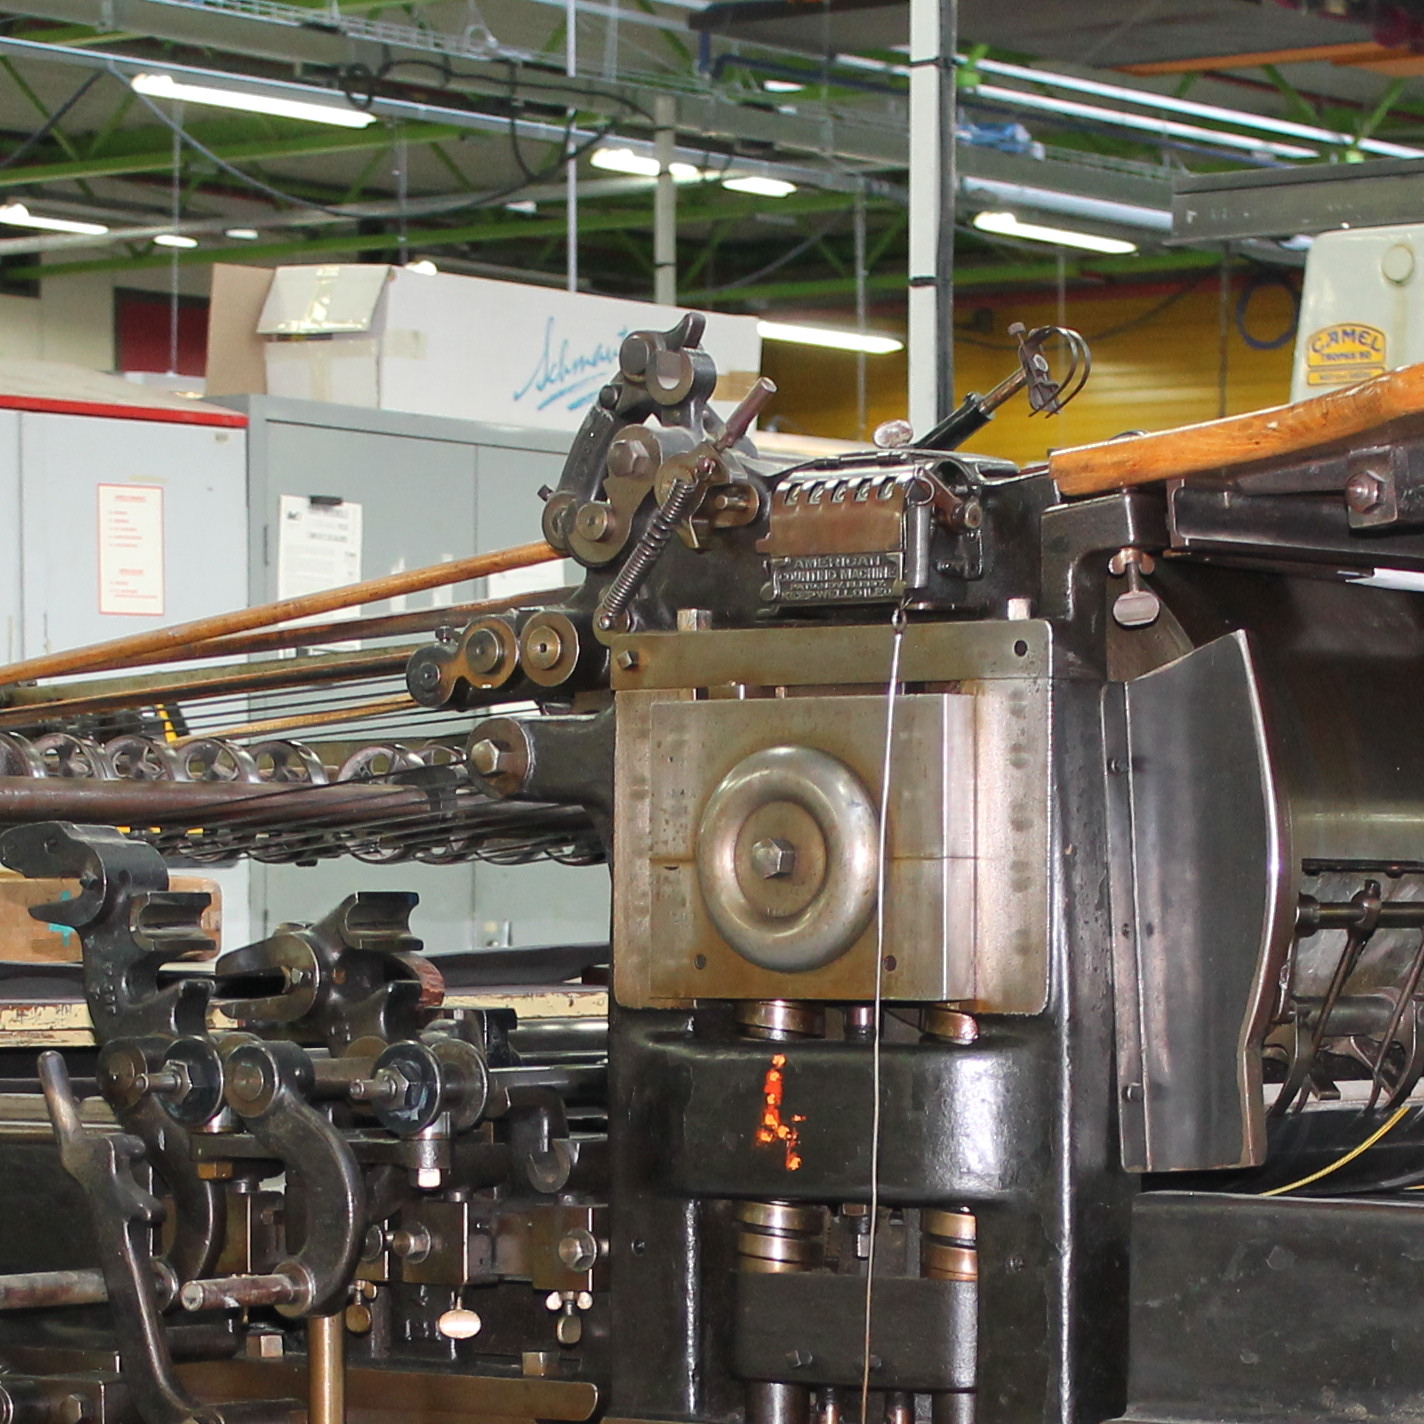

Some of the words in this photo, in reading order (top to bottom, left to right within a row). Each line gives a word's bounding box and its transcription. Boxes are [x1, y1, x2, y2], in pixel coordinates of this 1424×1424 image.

[1312, 329, 1381, 352] CAMEL
[794, 556, 881, 569] AMERICAN
[839, 566, 896, 580] MACHINE
